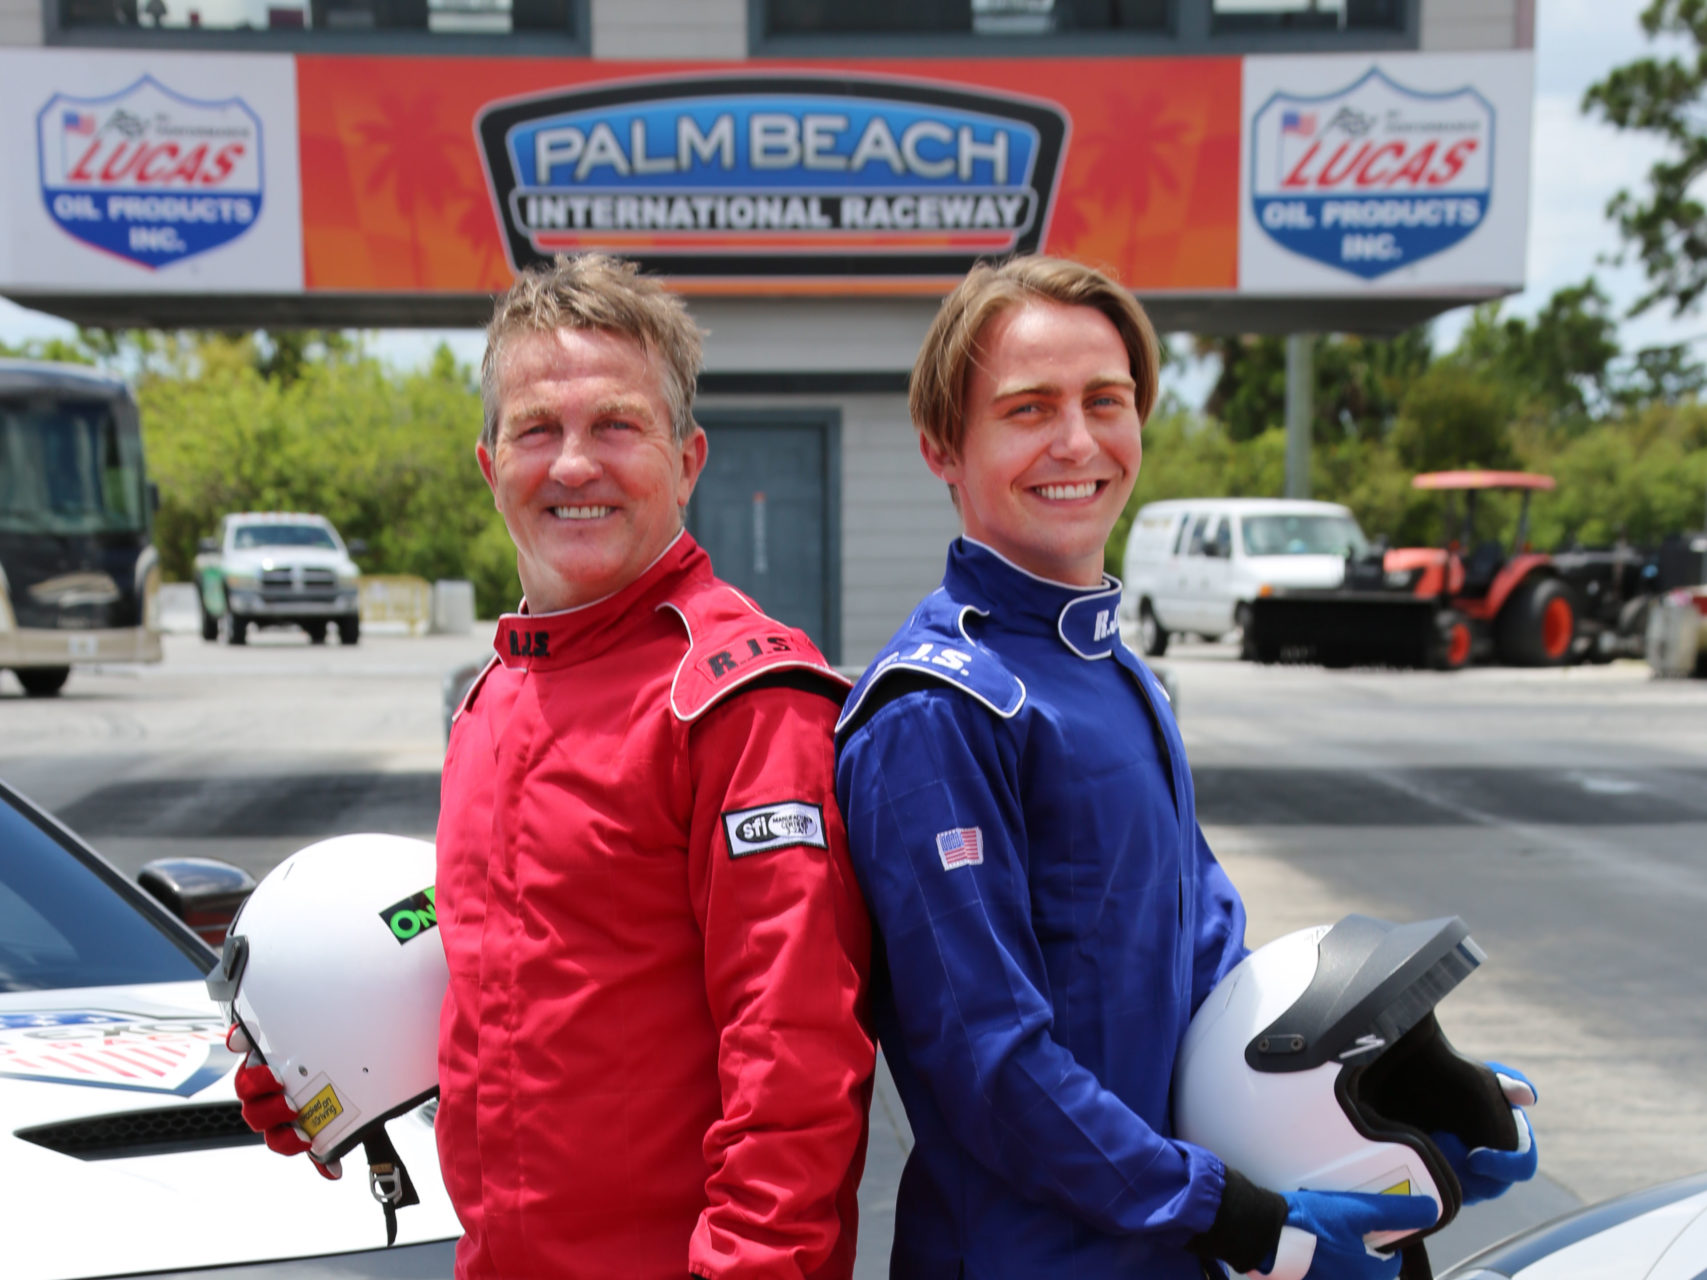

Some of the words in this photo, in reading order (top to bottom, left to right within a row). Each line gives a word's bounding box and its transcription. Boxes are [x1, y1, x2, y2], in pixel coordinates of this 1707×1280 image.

[67, 139, 245, 185] LUCAS
[535, 115, 734, 186] PALM
[749, 113, 1010, 184] BEACH
[1280, 138, 1480, 189] LUCAS
[53, 195, 101, 222] OIL
[107, 196, 254, 224] PRODUCTS
[526, 196, 832, 229] INTERNATIONAL
[839, 196, 1023, 229] RACEWAY
[1262, 199, 1315, 229] OIL
[1321, 197, 1481, 228] PRODUCTS
[129, 226, 187, 252] INC.
[1341, 233, 1403, 262] INC.
